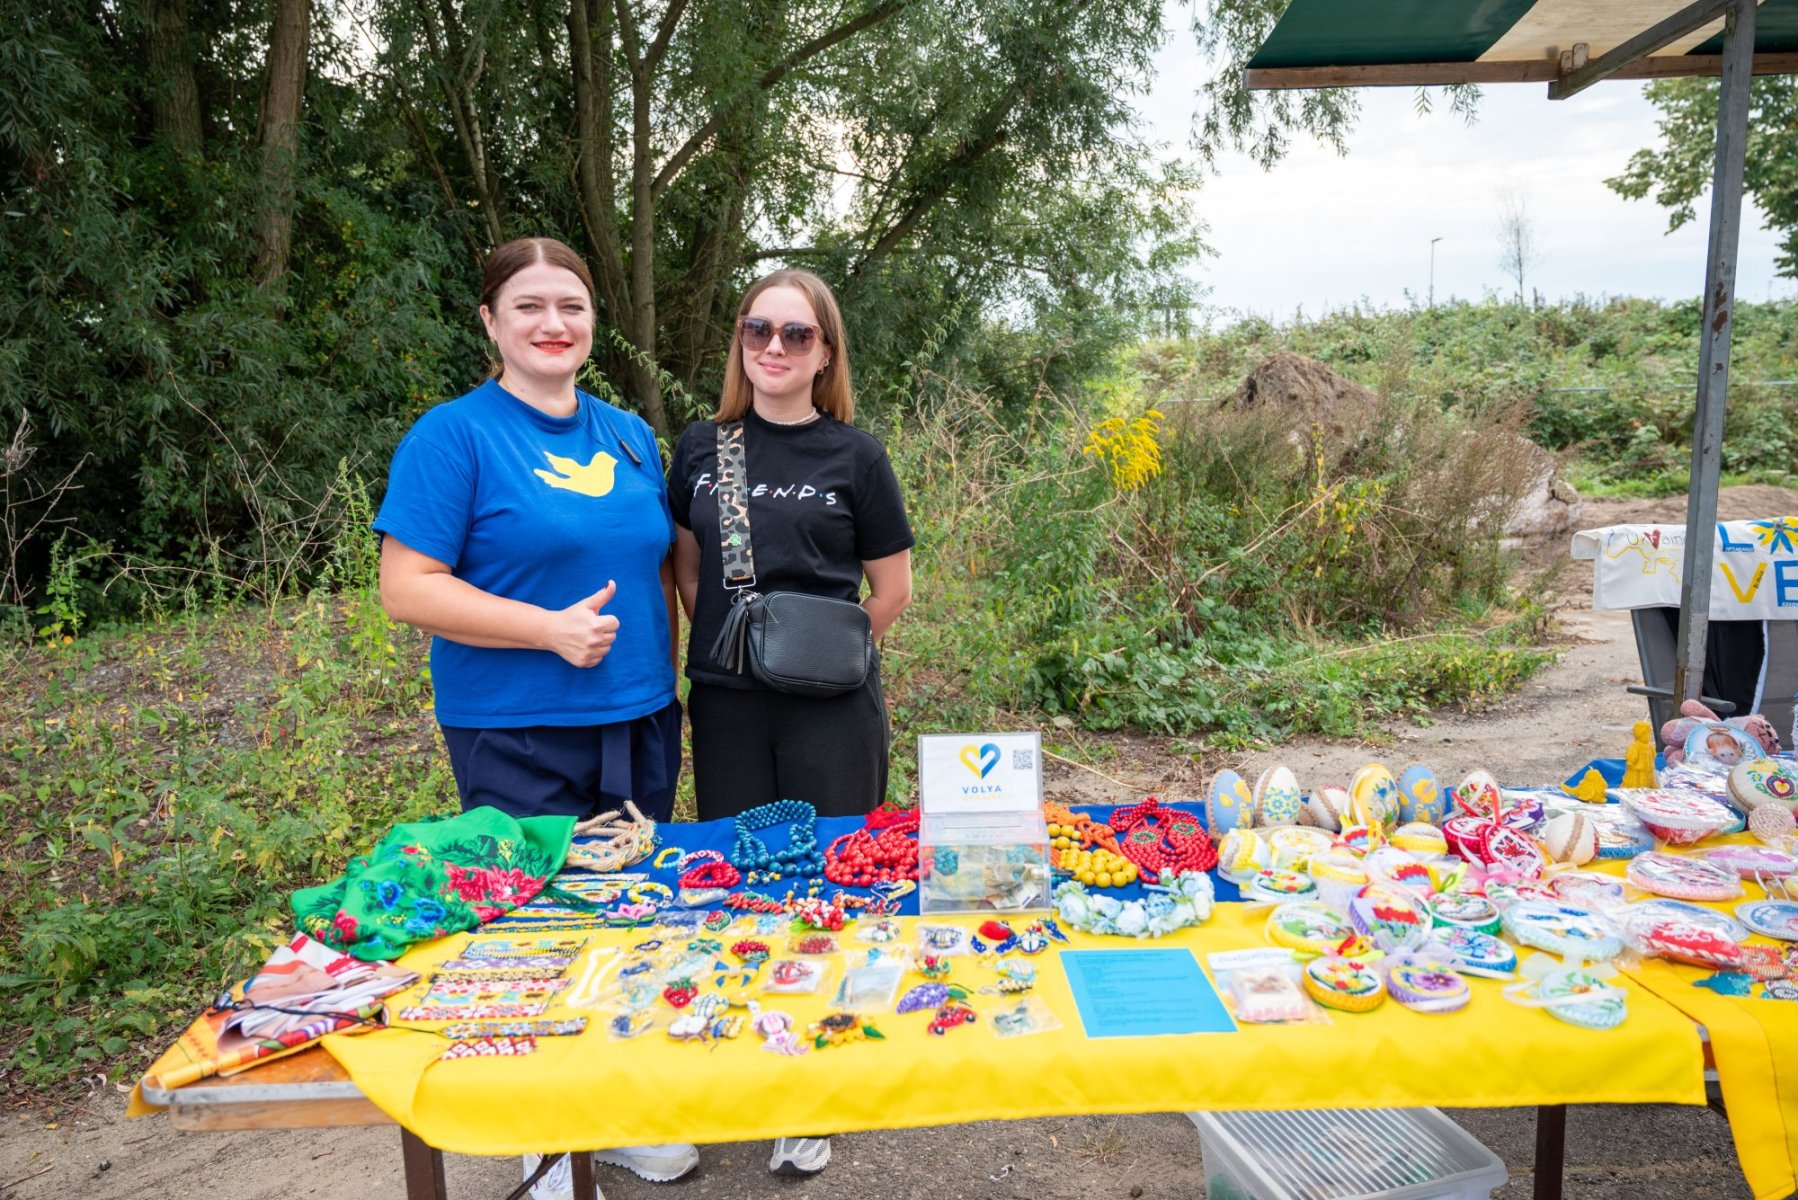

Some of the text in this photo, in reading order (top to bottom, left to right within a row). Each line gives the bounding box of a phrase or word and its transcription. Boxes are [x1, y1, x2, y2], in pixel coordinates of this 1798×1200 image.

[693, 473, 837, 506] FENDS
[1626, 532, 1686, 546] Ukrain
[962, 785, 1002, 794] VOLYA
